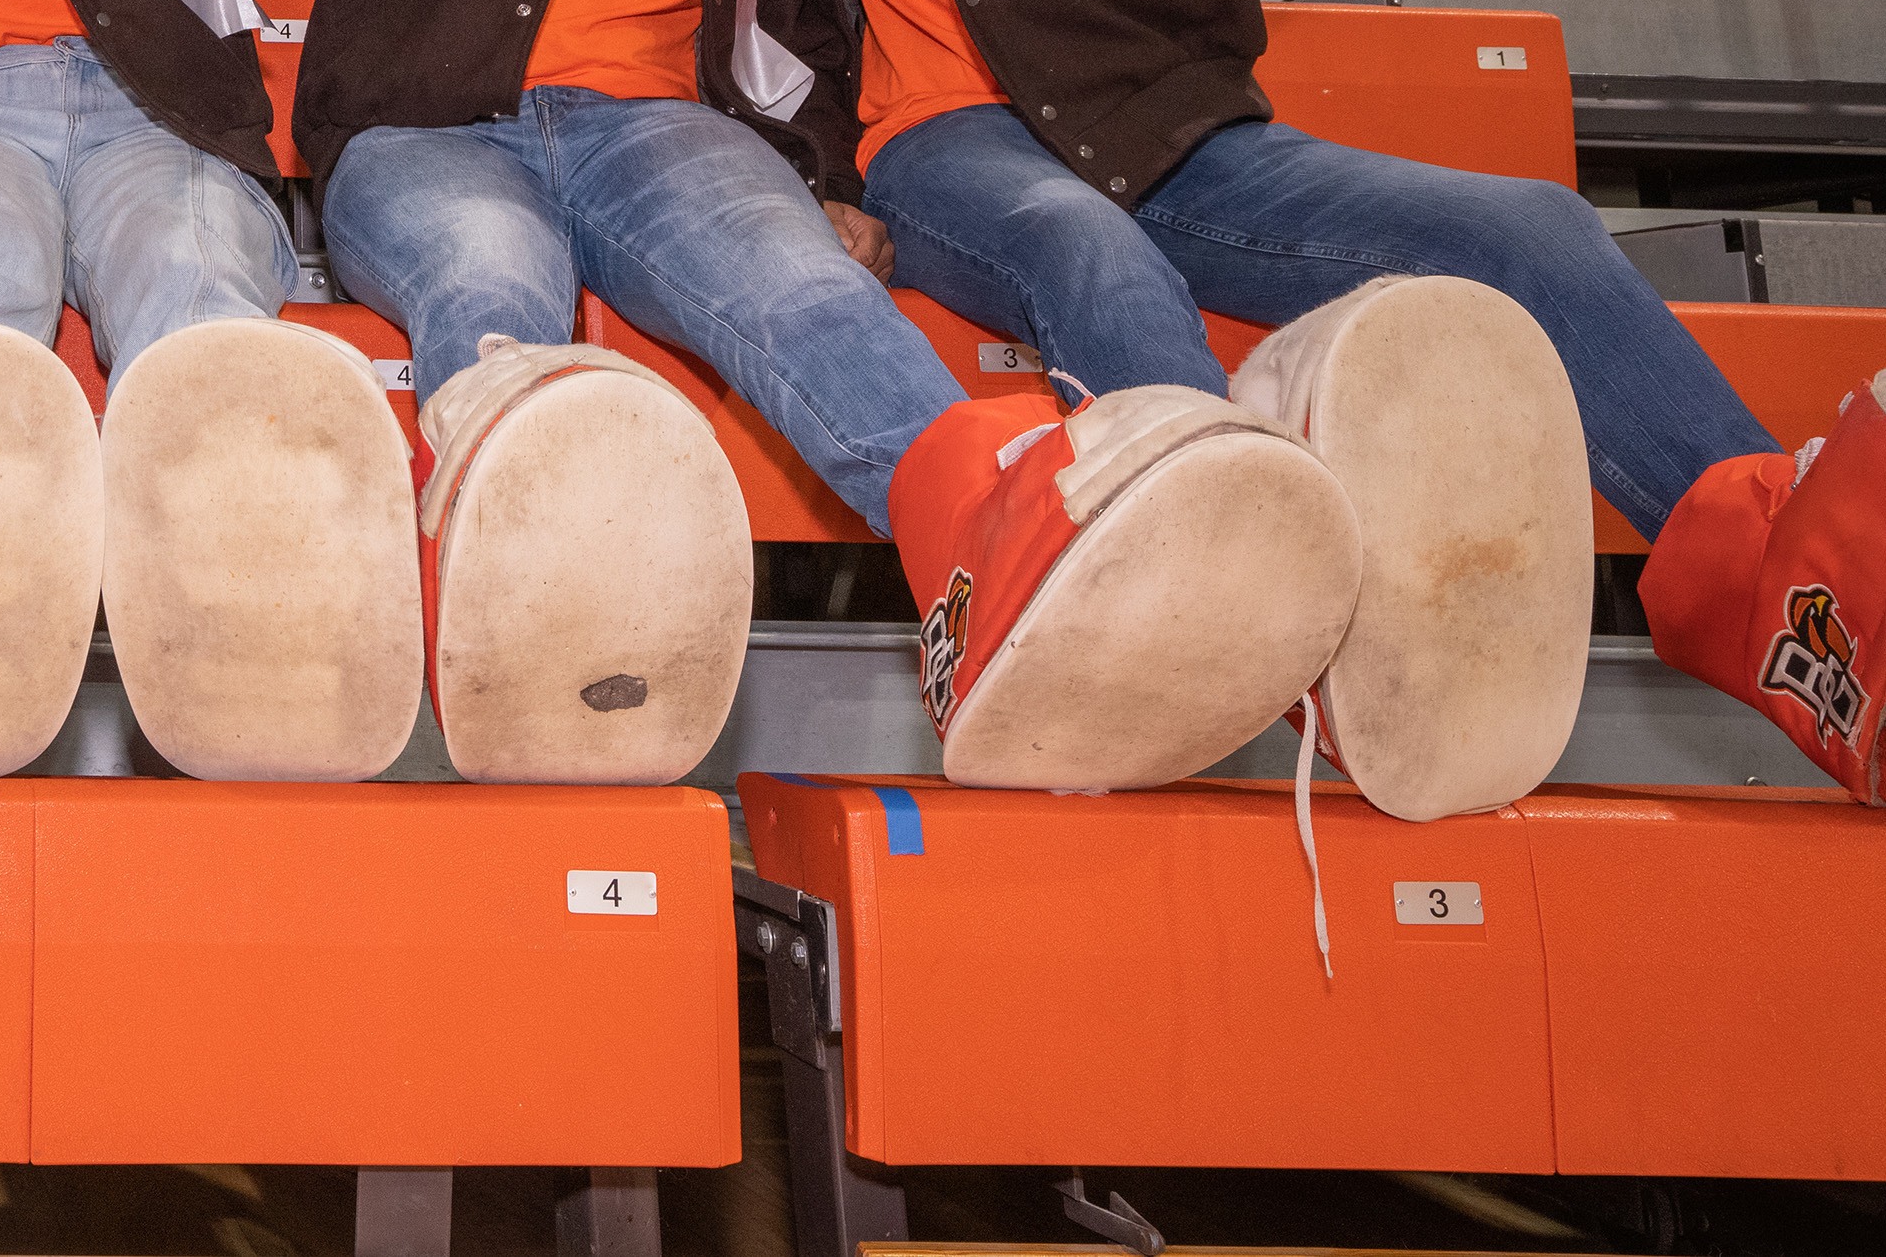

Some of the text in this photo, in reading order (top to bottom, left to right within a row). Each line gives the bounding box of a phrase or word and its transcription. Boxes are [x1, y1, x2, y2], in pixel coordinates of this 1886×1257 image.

[280, 23, 292, 39] 4
[1496, 50, 1505, 66] 1
[1003, 346, 1022, 369] 3
[397, 364, 412, 386] 4
[602, 878, 622, 908] 4
[1428, 888, 1449, 918] 3
